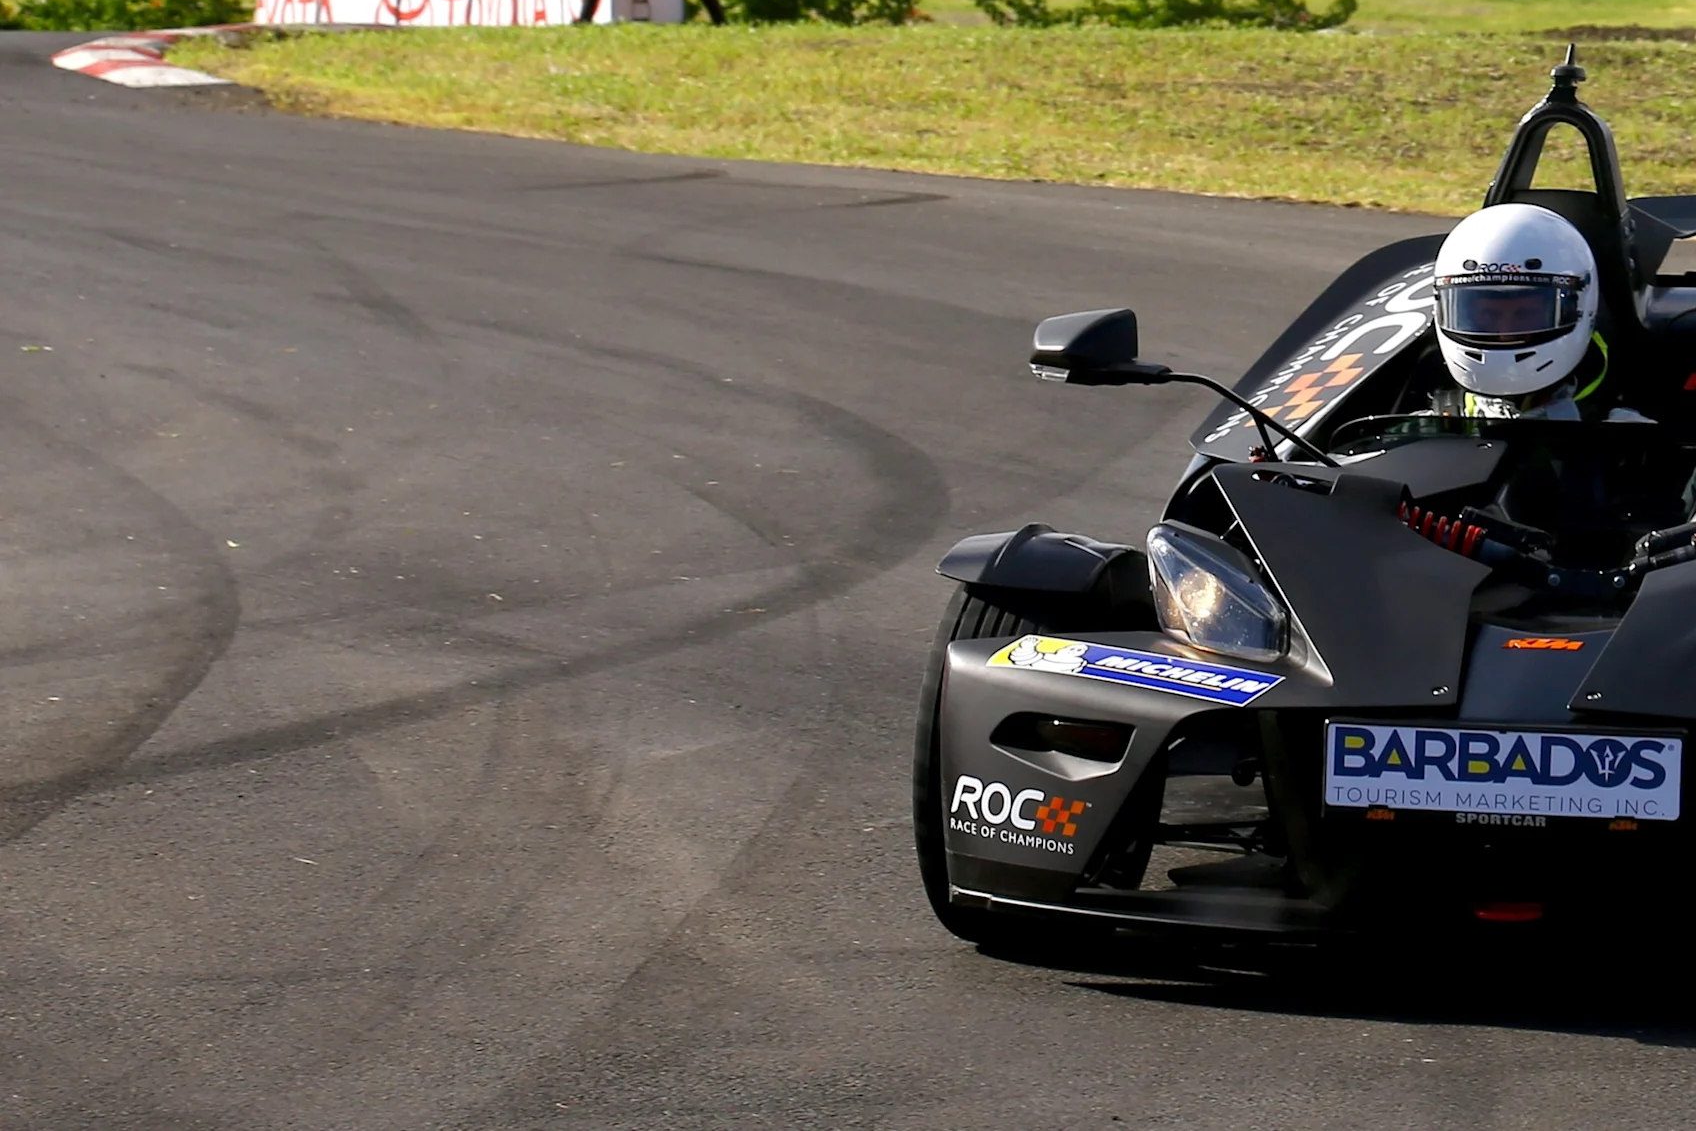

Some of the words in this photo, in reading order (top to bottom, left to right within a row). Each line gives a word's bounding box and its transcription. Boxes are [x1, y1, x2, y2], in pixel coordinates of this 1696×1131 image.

[1502, 637, 1585, 651] KTM
[1095, 655, 1270, 694] MICHELIN
[1333, 726, 1667, 790] BARBADOS
[950, 774, 1046, 831] ROC
[1333, 785, 1442, 806] TOURISM
[1455, 791, 1603, 814] MARKETING
[1615, 798, 1666, 817] INC.
[1455, 812, 1547, 827] SPORTCAR
[950, 817, 978, 836] RACE
[980, 825, 997, 840] OF
[999, 829, 1075, 855] CHAMPIONS
